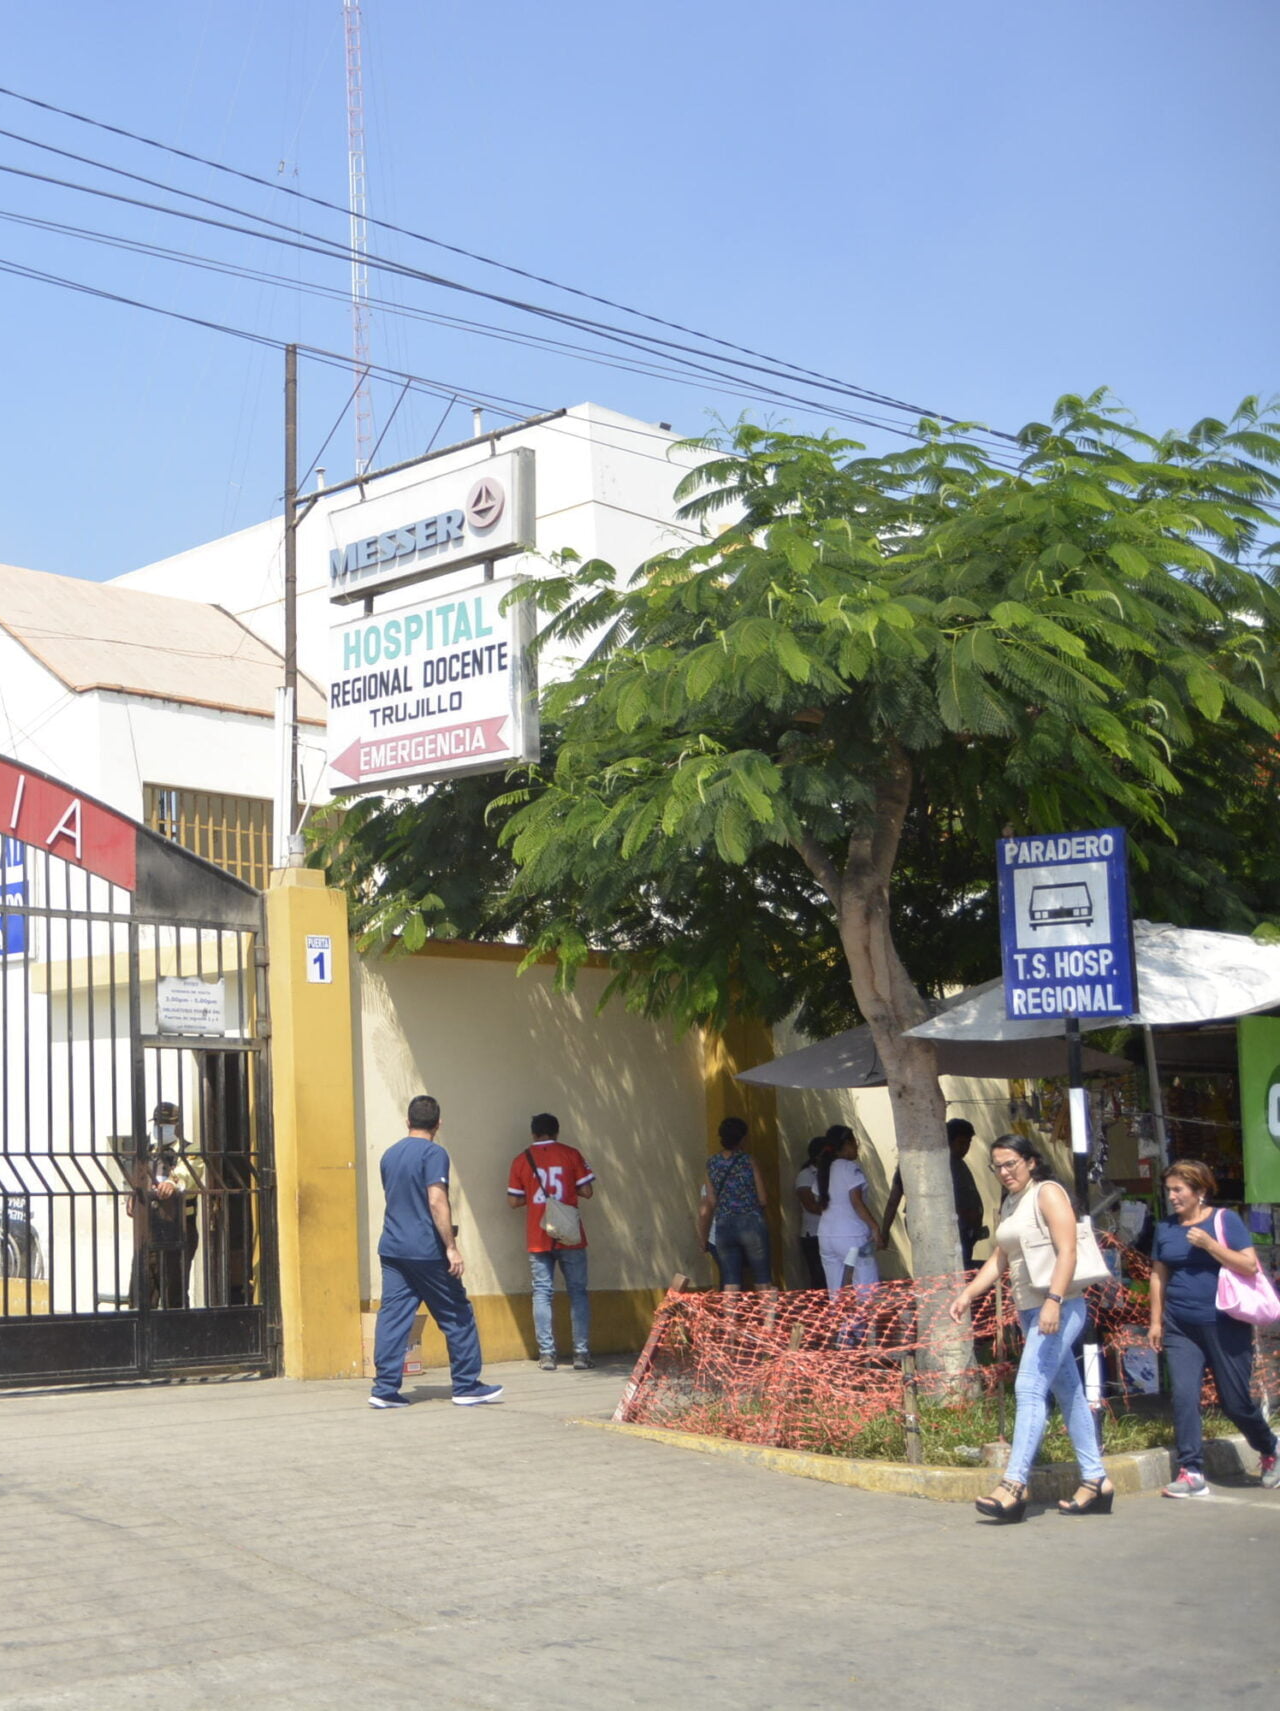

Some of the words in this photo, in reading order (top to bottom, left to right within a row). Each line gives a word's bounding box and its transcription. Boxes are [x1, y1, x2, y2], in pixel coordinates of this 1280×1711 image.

[330, 509, 465, 580] MESSER
[343, 596, 493, 671] HOSPITAL
[331, 666, 413, 709] REGIONAL
[423, 641, 508, 689] DOCENTE
[369, 690, 463, 729] TRUJILLO
[360, 725, 486, 772] EMERGENCIA
[1004, 834, 1114, 865] PARADERO
[313, 951, 325, 980] 1
[1013, 953, 1050, 980] T.S.
[1055, 949, 1117, 978] HOSP.
[1012, 984, 1123, 1015] REGIONAL
